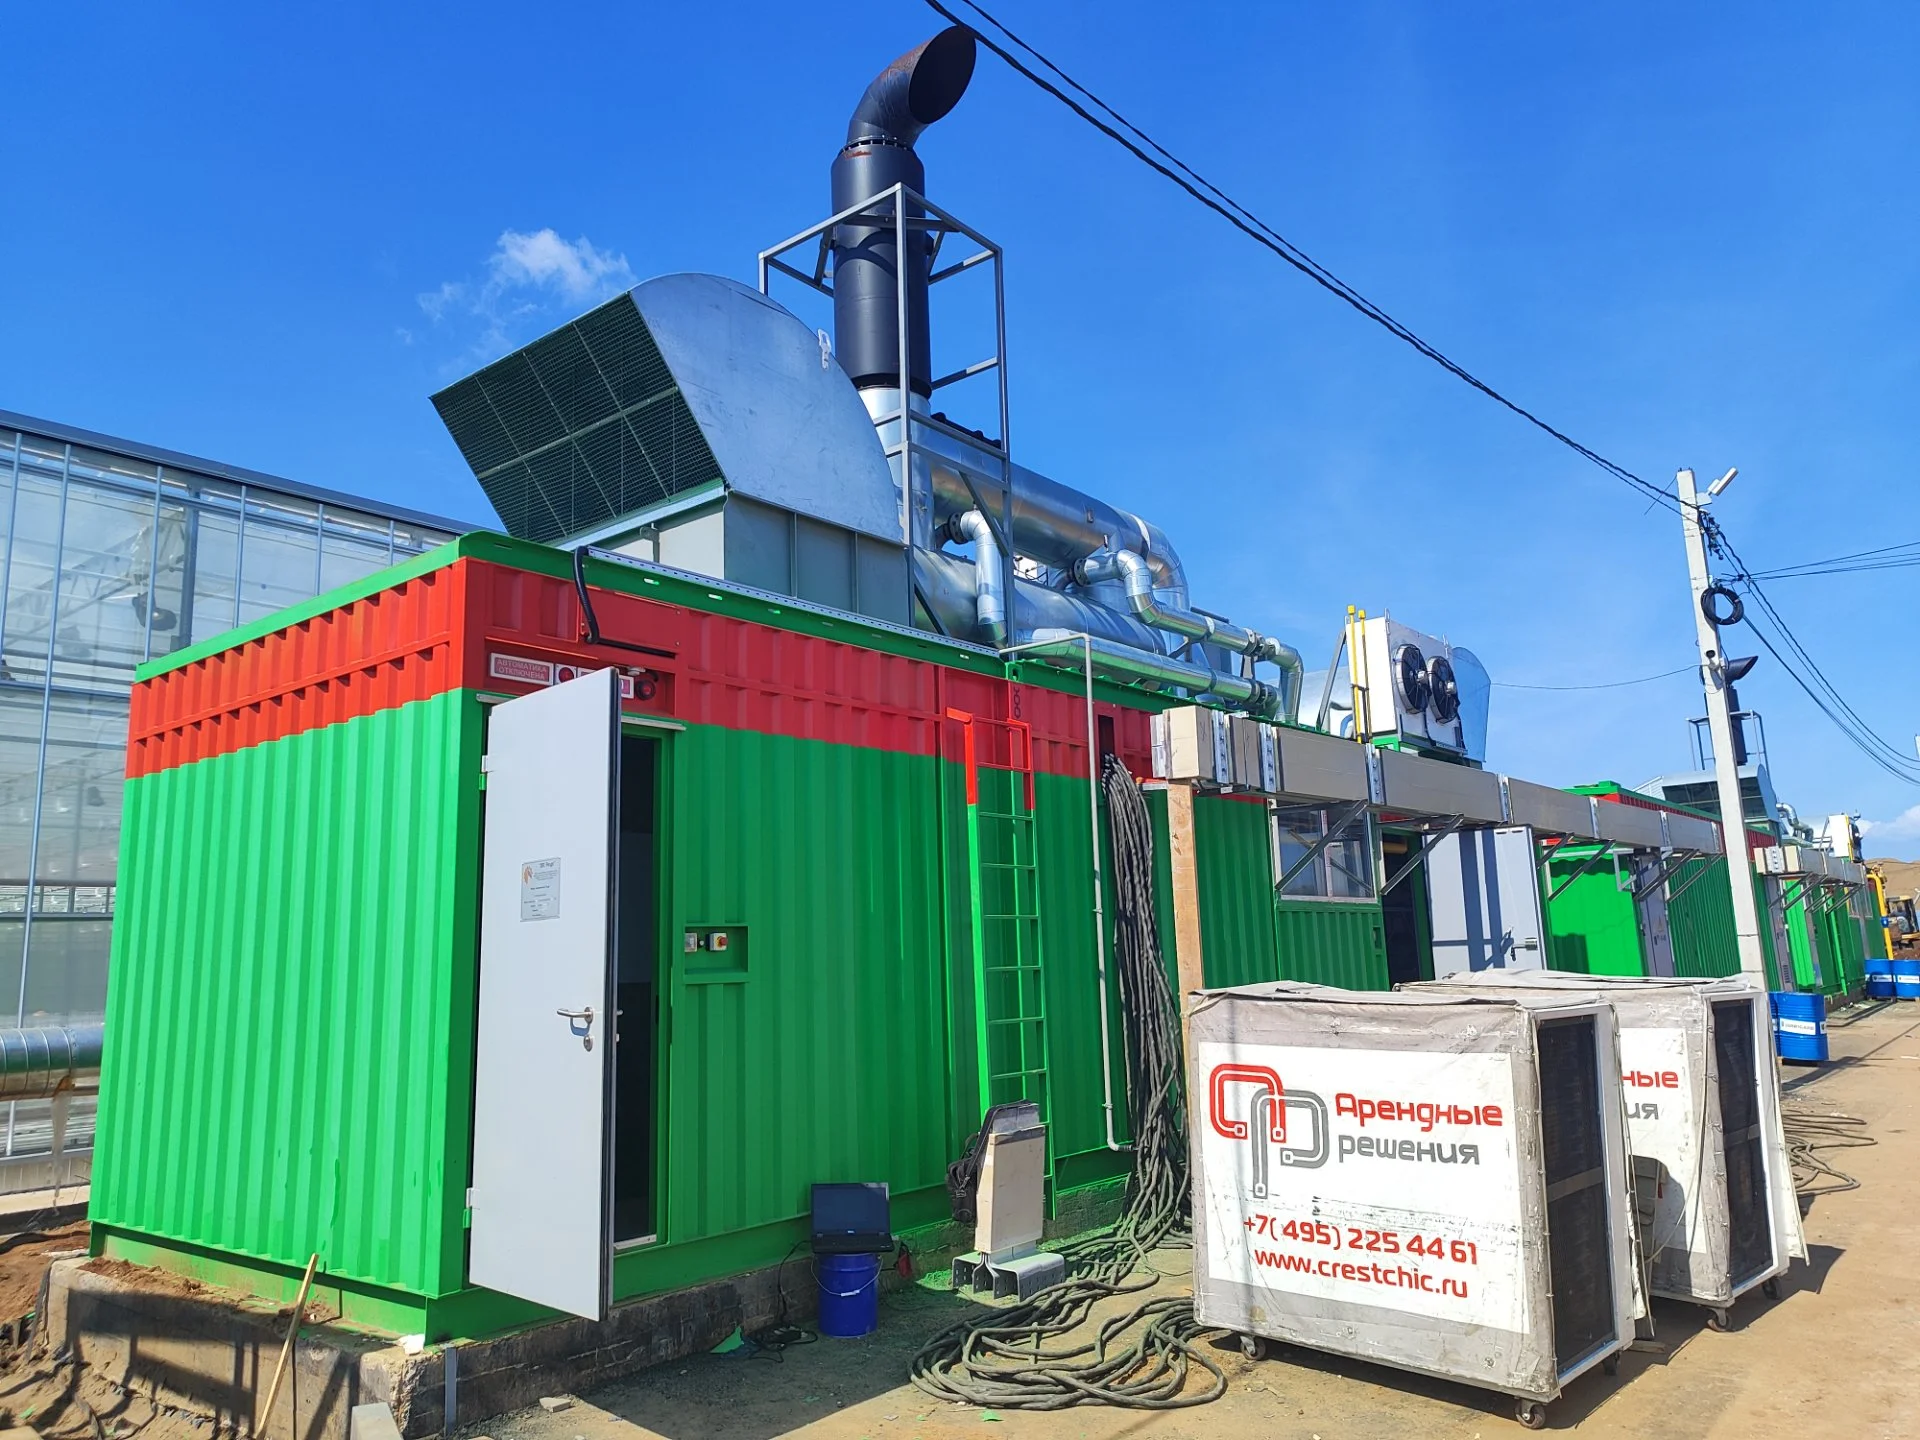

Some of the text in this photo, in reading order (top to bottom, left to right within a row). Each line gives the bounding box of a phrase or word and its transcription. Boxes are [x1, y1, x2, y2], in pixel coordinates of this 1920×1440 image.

[497, 658, 547, 673] АВТОМАТИКА
[498, 667, 546, 681] ОТКЛЮЧЕНА
[1335, 1093, 1502, 1132] Арендные
[1338, 1135, 1480, 1165] решения
[1347, 1228, 1400, 1254] 225
[1406, 1235, 1445, 1260] 44
[1450, 1240, 1477, 1265] 61
[1254, 1249, 1468, 1298] www.crestchic.ru
